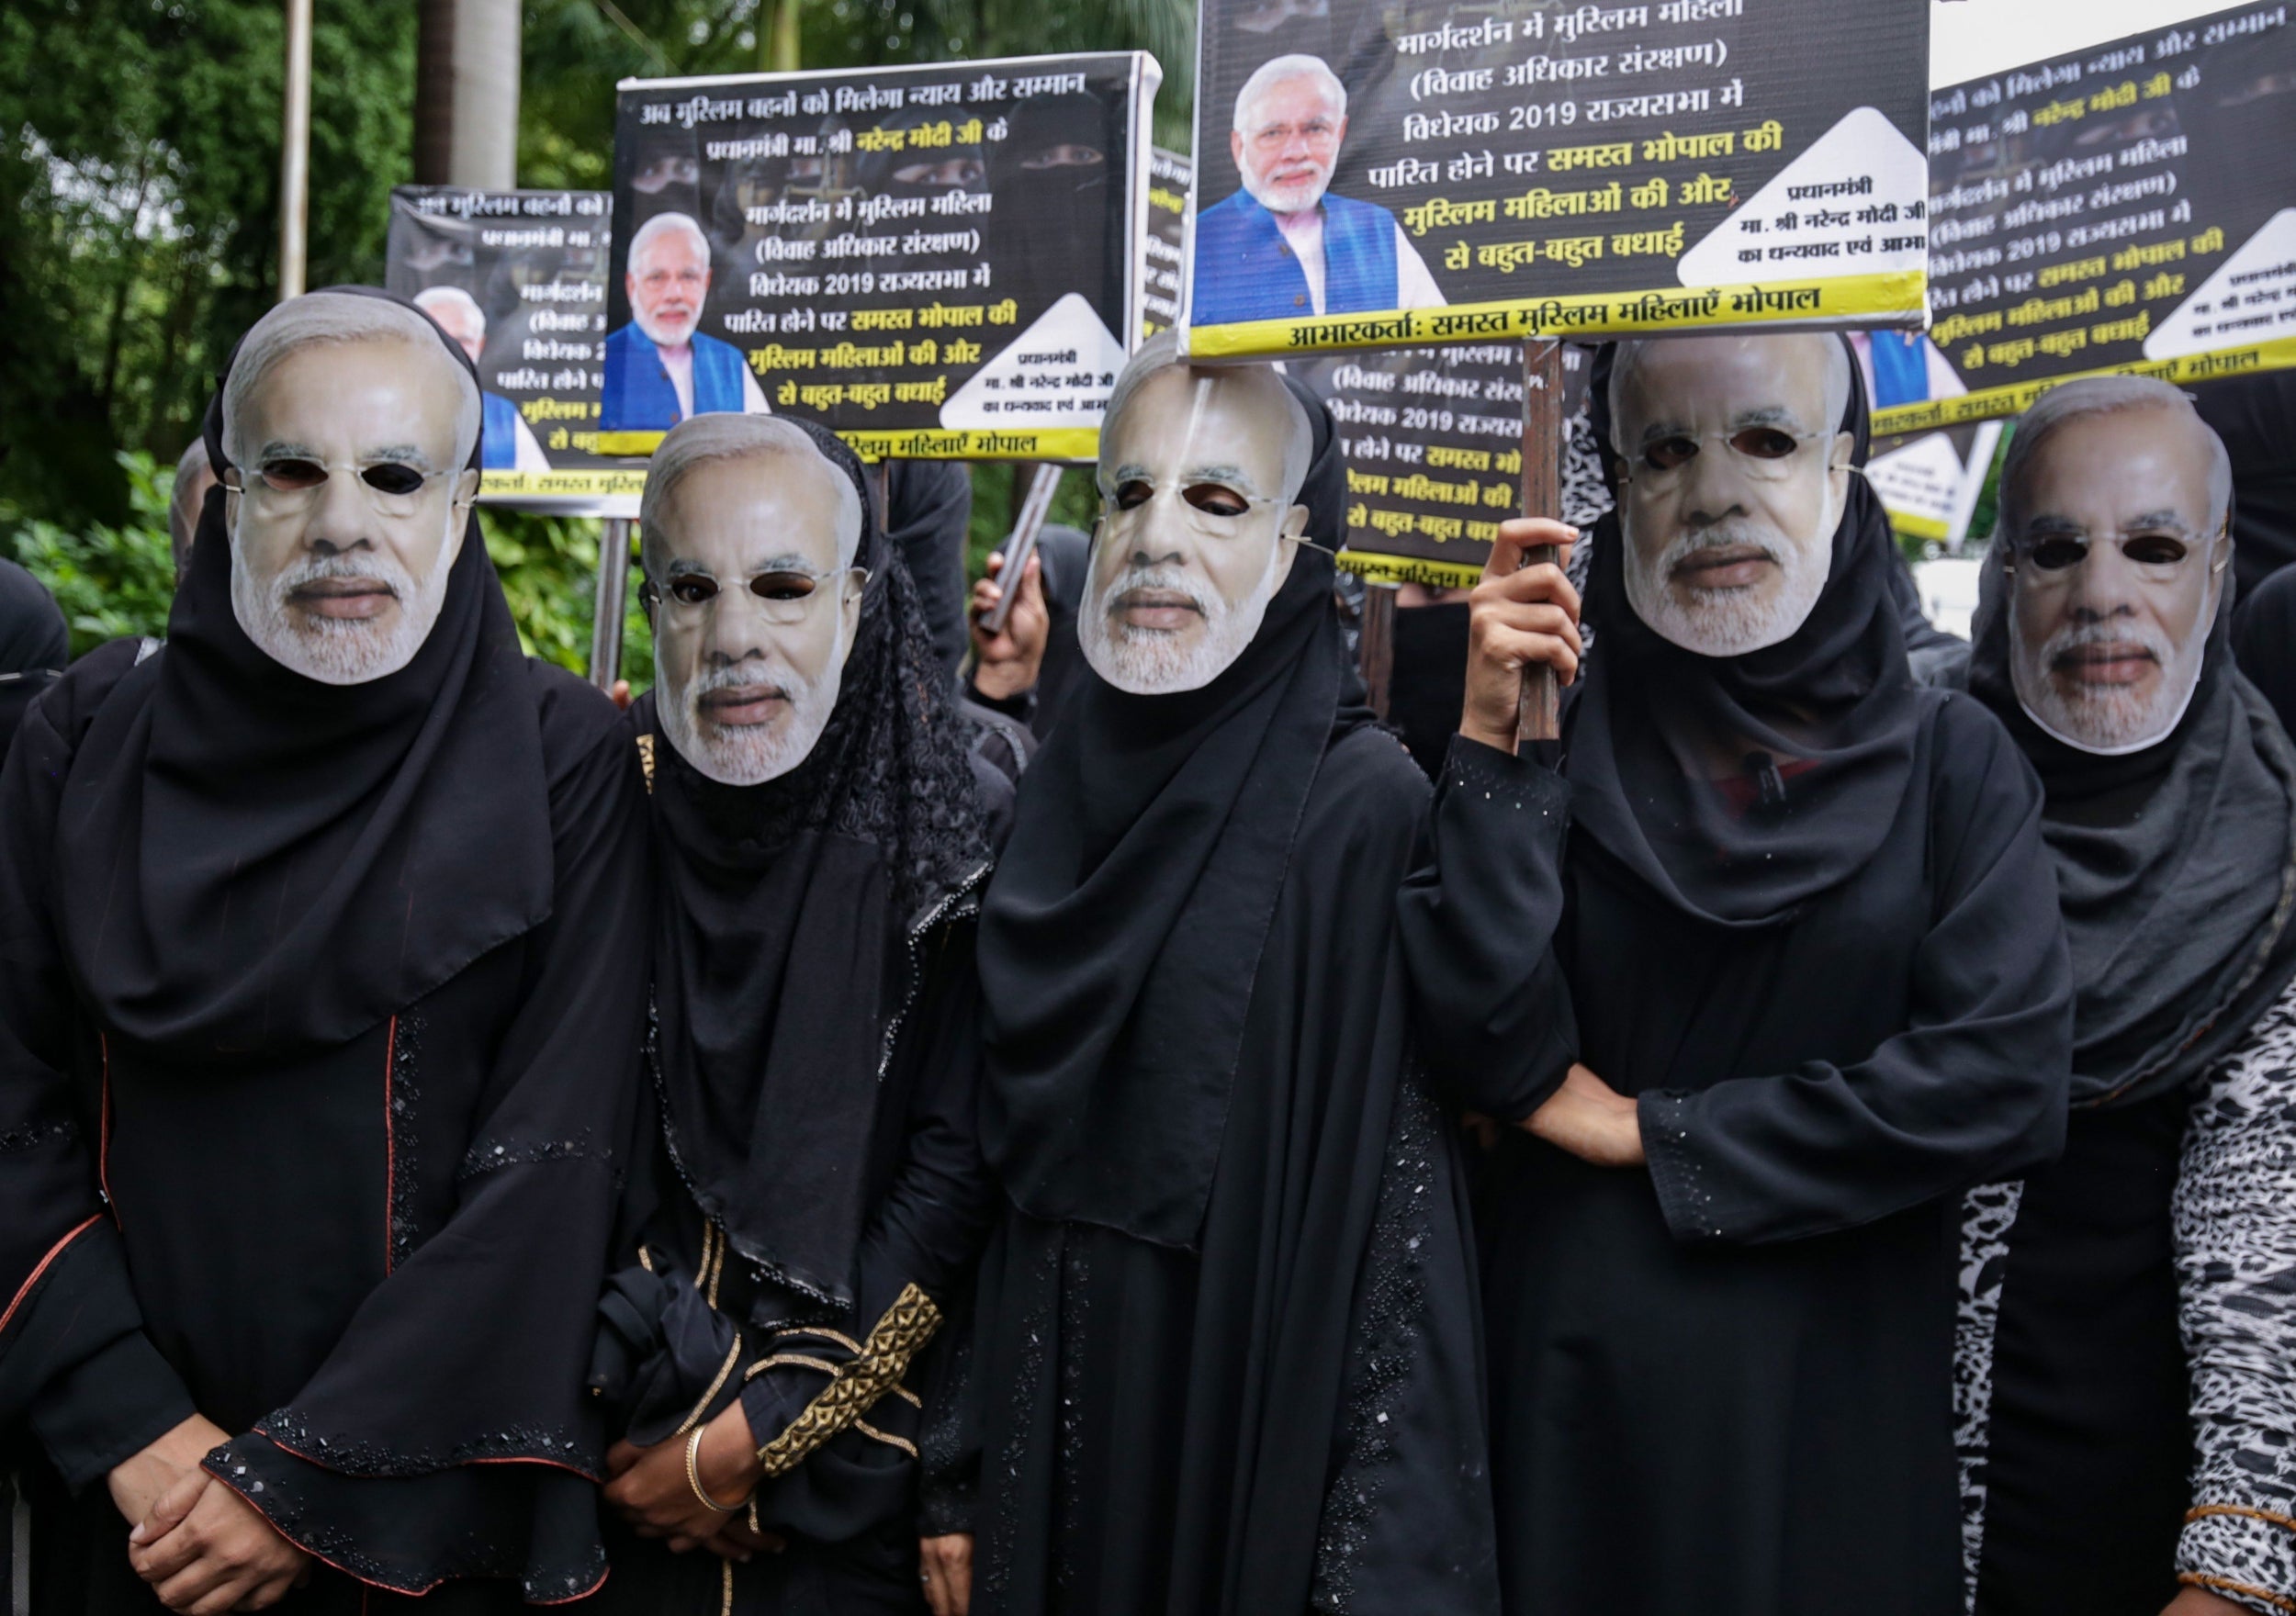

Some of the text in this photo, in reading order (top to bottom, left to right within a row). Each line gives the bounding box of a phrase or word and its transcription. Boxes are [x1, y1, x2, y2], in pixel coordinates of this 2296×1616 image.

[1397, 0, 1743, 55] मार्गदर्शन में मुस्लिम महिला
[1410, 38, 1728, 102] (विवाह अधिकार संरक्षण)
[640, 103, 671, 125] अब
[676, 95, 743, 129] मुस्लिम
[802, 87, 829, 115] को
[835, 84, 904, 113] मिलेगा
[908, 83, 962, 106] न्याय
[967, 73, 1007, 102] और
[1012, 73, 1086, 99] सम्मान
[1403, 78, 1744, 142] विधेयक 2019 राज्यसभा में
[706, 131, 789, 161] प्रधानमंत्री
[827, 128, 852, 154] श्री
[856, 125, 906, 152] नरेन्द्र
[908, 120, 952, 149] मोदी
[955, 118, 983, 144] जी
[986, 116, 1008, 141] के
[1367, 119, 1784, 189] पारित होने पर समस्त भोपाल की
[746, 188, 993, 227] मार्गदर्शन में मुस्लिम महिला
[1403, 173, 1733, 237] मुस्लिम महिलाओं की और
[1787, 174, 1874, 202] प्रधानमंत्री
[1740, 199, 1926, 234] मा. श्री नरेन्द्र मोदी जी
[755, 228, 981, 264] (विवाह अधिकार संरक्षण)
[1444, 221, 1685, 274] से बहुत-बहुत बधाई
[1738, 248, 1762, 264] का
[1769, 241, 1840, 262] धन्यवाद
[1846, 235, 1872, 256] एवं
[2006, 230, 2062, 263] 2019
[2111, 243, 2187, 272] भोपाल
[2190, 226, 2224, 254] की
[748, 262, 991, 297] विधेयक 2019 राज्यसभा में
[724, 297, 1019, 333] पारित होने पर समस्त भोपाल की
[1289, 286, 1822, 347] आभारकर्ता: समस्त मुस्लिम महिलाएँ भोपाल
[1930, 309, 2003, 348] मुस्लिम
[2103, 278, 2136, 308] की
[2142, 272, 2186, 300] और
[748, 336, 982, 376] मुस्लिम महिलाओं की और
[777, 374, 948, 411] से बहुत-बहुत बधाई
[1400, 369, 1481, 398] अधिकार
[1401, 407, 1453, 432] 2019
[898, 432, 1038, 457] महिलाएँ भोपाल
[1354, 435, 1391, 461] होने
[1394, 440, 1424, 465] पर
[1425, 444, 1491, 472] समस्त
[1392, 473, 1480, 506] महिलाओं
[1482, 482, 1514, 510] की
[1345, 501, 1463, 544] से बहुत-बहुत
